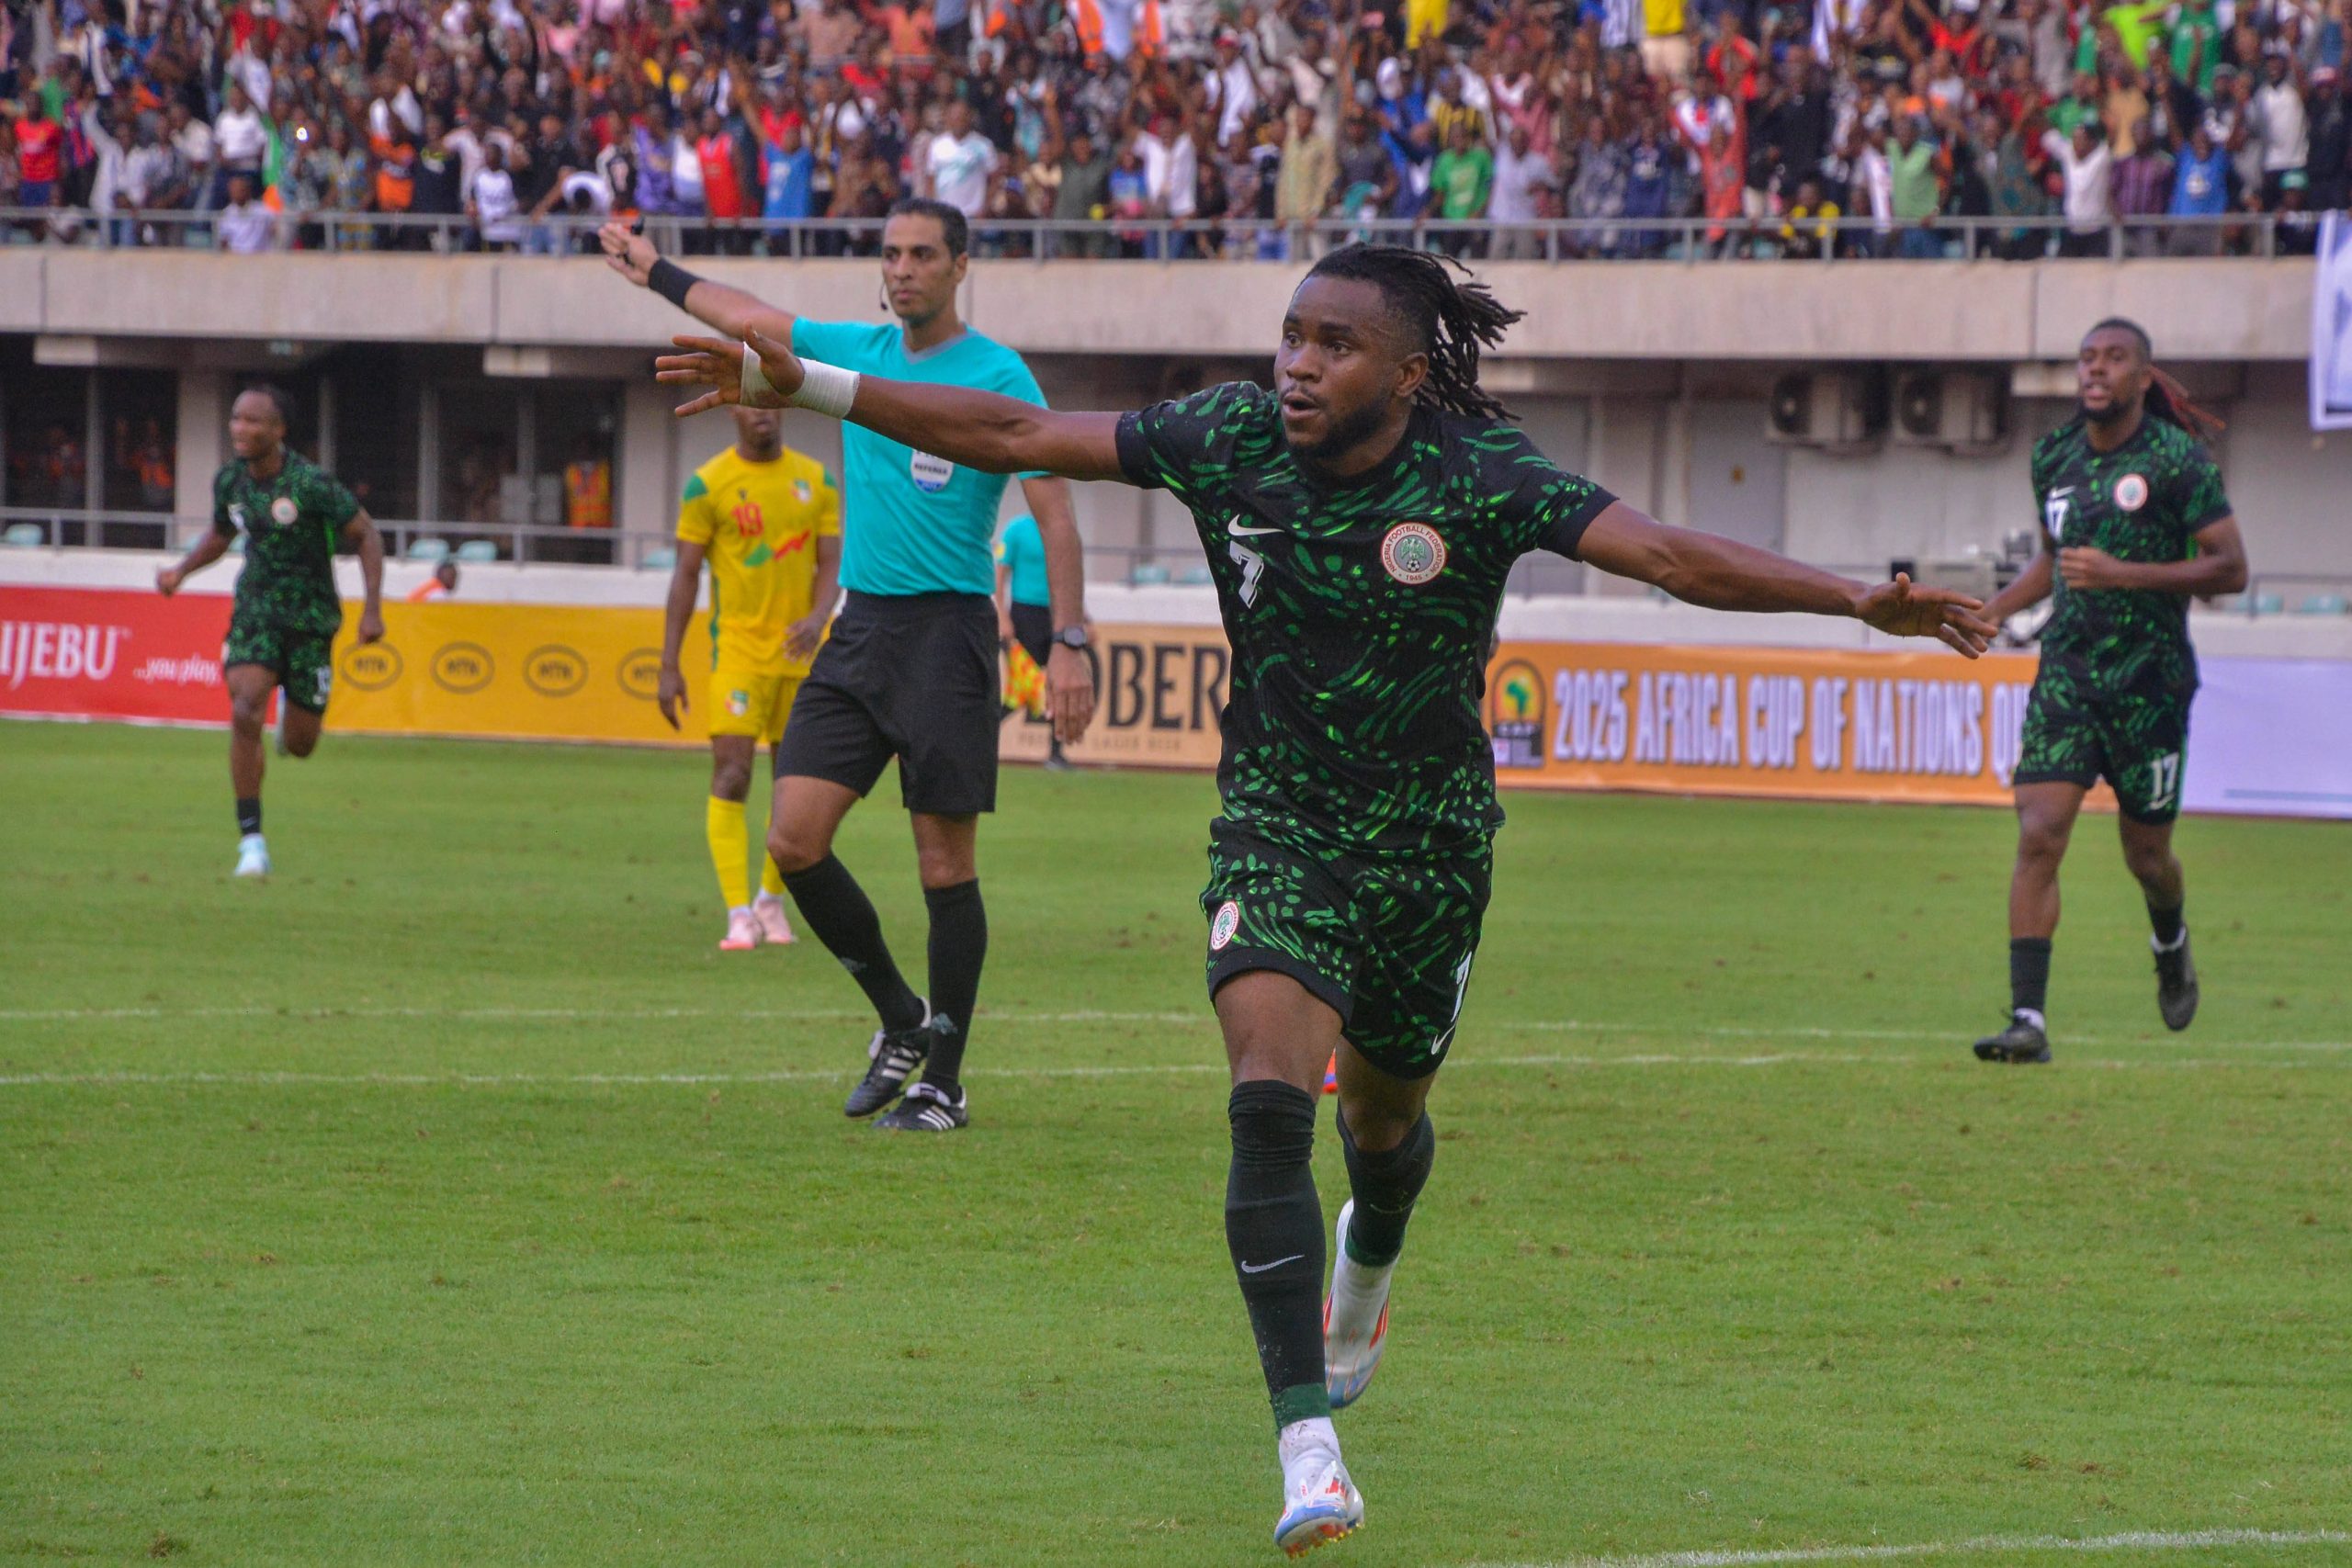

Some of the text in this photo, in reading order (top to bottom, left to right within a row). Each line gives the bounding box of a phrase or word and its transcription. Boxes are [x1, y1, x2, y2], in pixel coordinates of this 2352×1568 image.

[731, 502, 764, 539] 19
[1388, 525, 1424, 543] FOOTBALL
[2044, 499, 2069, 540] 17
[1229, 540, 1264, 609] 7
[1553, 668, 1629, 761] 2025
[1634, 670, 1739, 766] AFRICA
[1747, 673, 1804, 769] CUP
[1811, 675, 1848, 772] OF
[1852, 677, 1983, 776] NATIONS
[2150, 751, 2179, 801] 17
